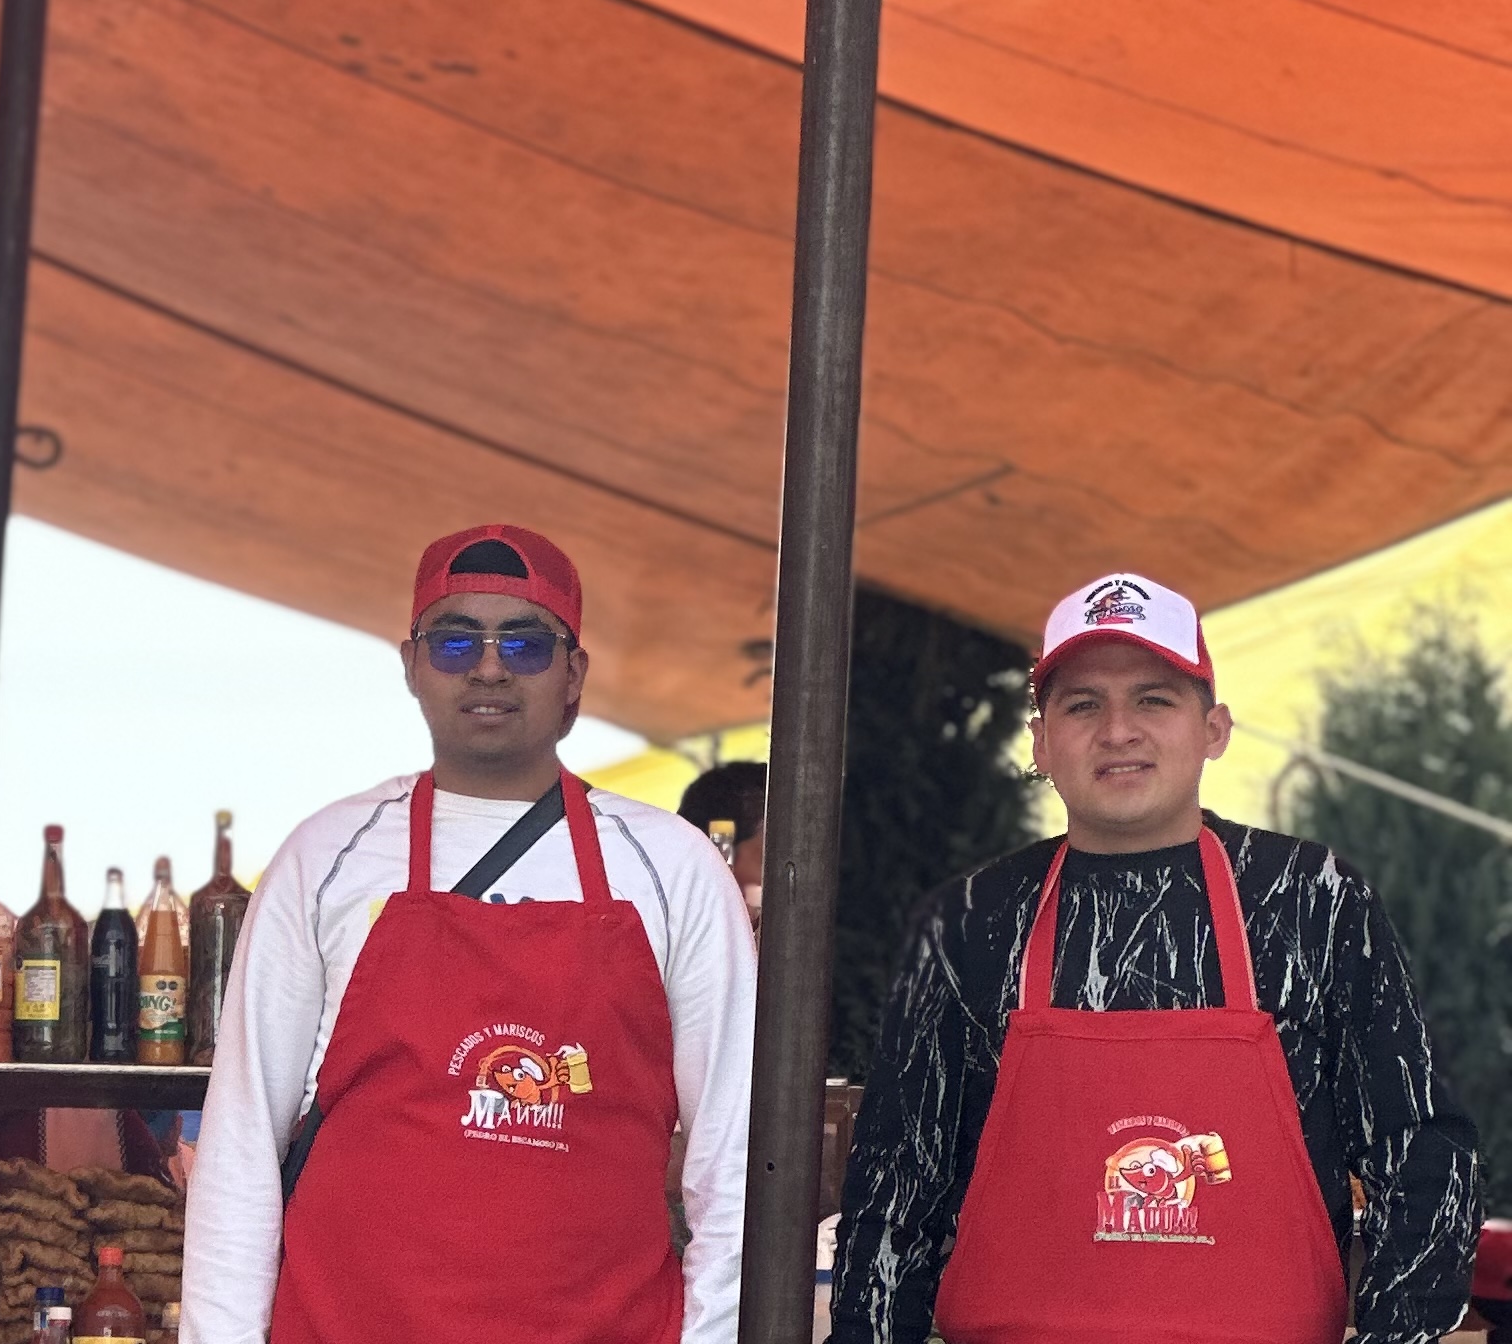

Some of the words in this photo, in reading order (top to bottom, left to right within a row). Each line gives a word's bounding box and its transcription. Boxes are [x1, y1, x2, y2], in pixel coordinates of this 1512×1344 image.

[448, 1032, 484, 1076] PESCADOS
[483, 1027, 492, 1038] Y
[493, 1023, 545, 1047] MARISCOS
